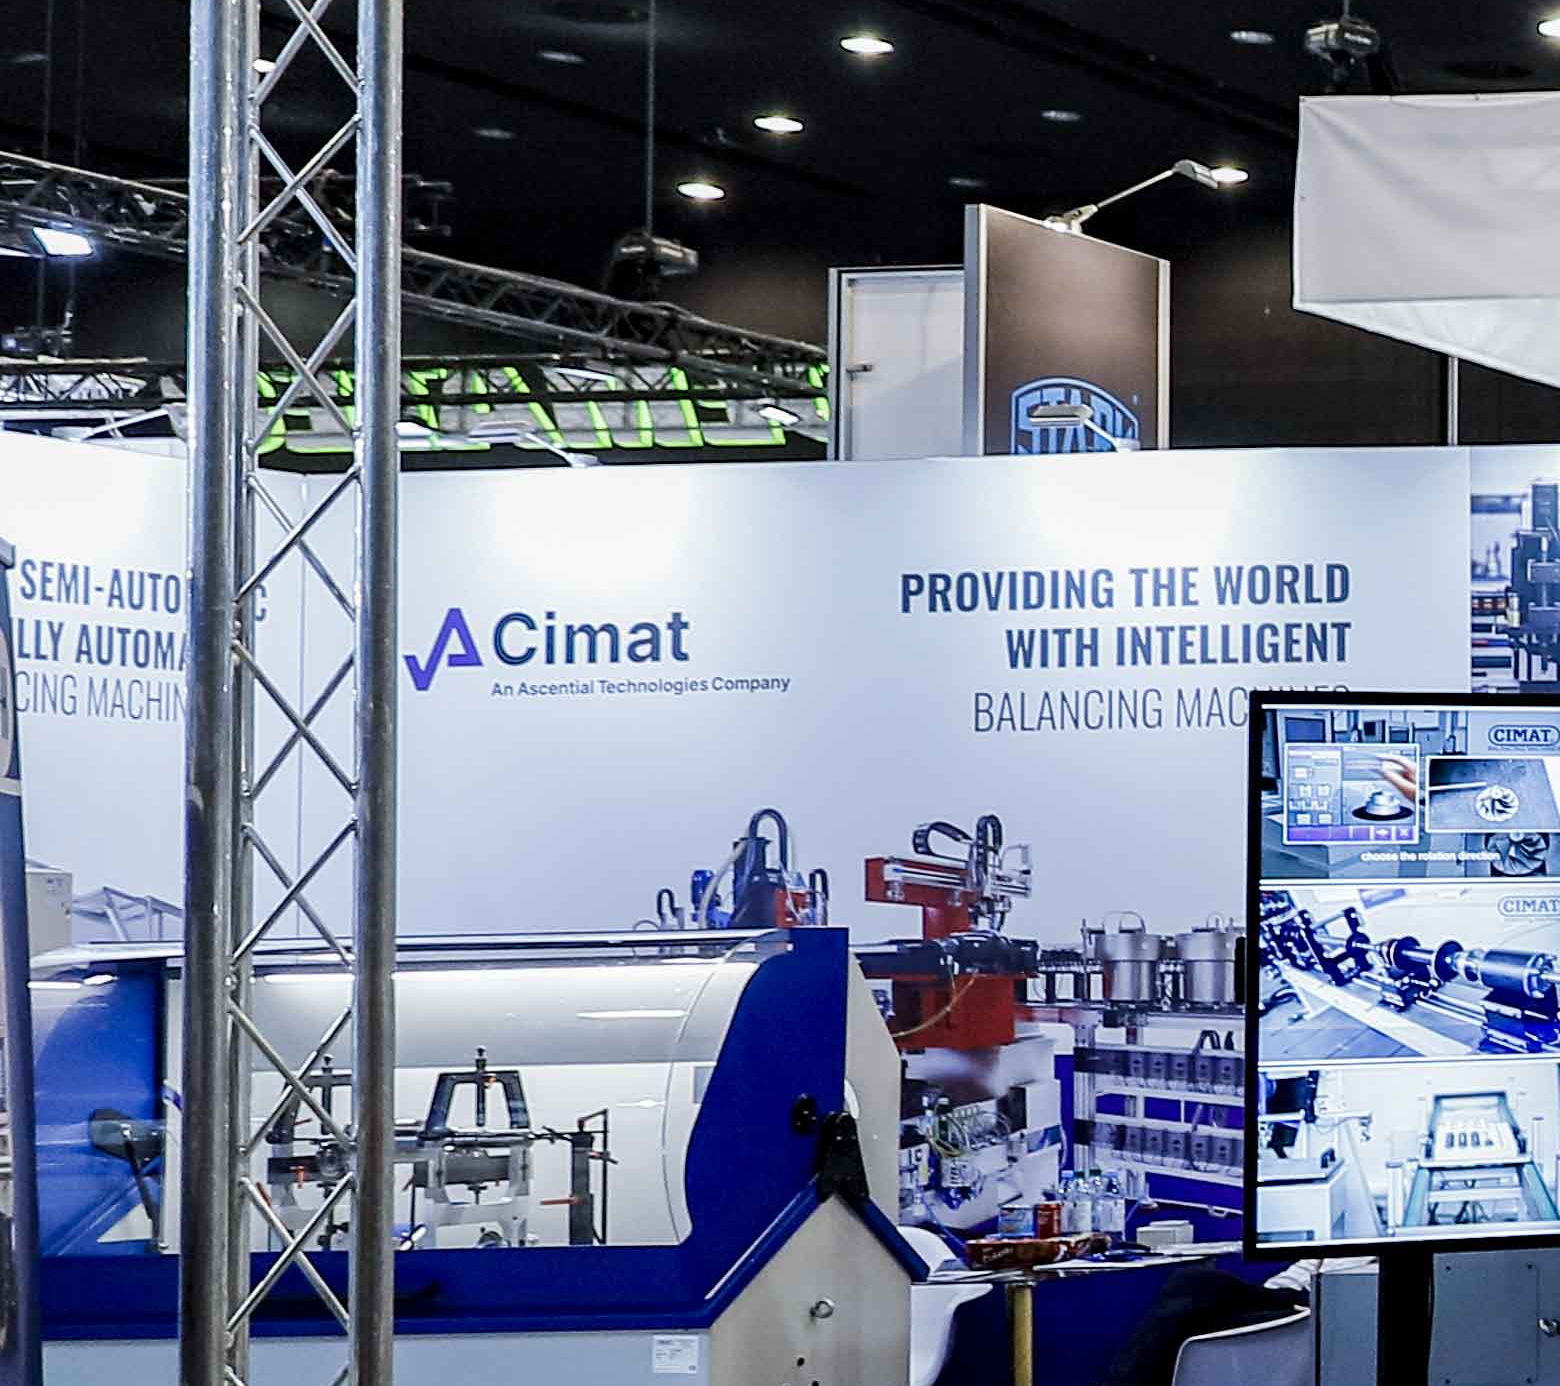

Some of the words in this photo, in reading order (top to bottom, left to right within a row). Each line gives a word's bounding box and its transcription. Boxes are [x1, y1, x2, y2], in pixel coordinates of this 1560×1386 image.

[901, 567, 1114, 613] PROVIDING
[1130, 567, 1199, 608] THE
[1213, 562, 1351, 606] WORLD
[17, 618, 64, 662] LLY
[493, 611, 690, 666] Cimat
[1005, 626, 1100, 670] WITH
[1114, 621, 1352, 666] INTELLIGENT
[87, 676, 187, 722] MACHIN
[491, 682, 515, 697] An
[517, 680, 595, 696] Ascential
[600, 678, 708, 695] Technologies
[711, 675, 792, 695] Company
[973, 688, 1163, 732] BALANCING
[1493, 728, 1552, 744] CIMAT
[1360, 851, 1398, 862] choose
[1400, 851, 1416, 862] the
[1418, 851, 1457, 862] rotation
[1457, 851, 1501, 862] direction
[1503, 899, 1559, 914] CIMAT
